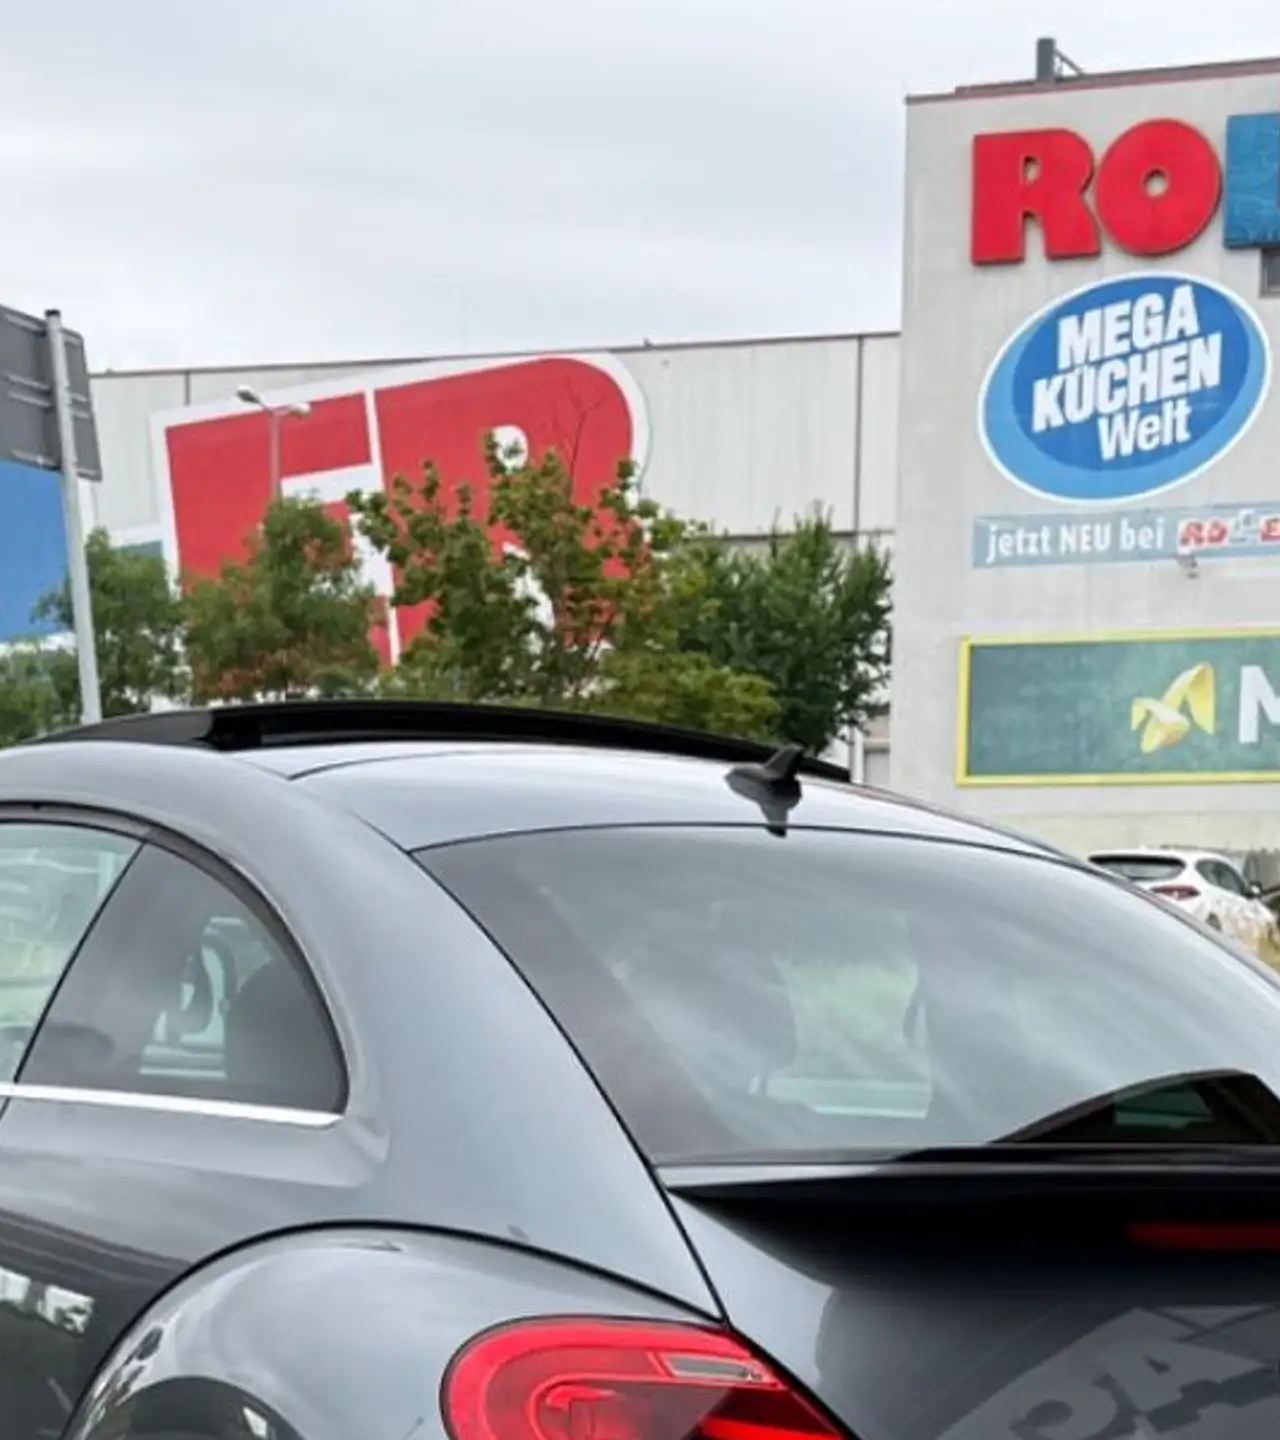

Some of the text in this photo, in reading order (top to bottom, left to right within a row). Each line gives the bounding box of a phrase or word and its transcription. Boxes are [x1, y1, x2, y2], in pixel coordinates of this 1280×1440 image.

[1058, 283, 1200, 370] MEGA
[1032, 332, 1222, 433] KÜCHEN
[1097, 400, 1191, 461] Welt
[986, 525, 1051, 565] jetzt
[1059, 522, 1112, 555] NEU
[1120, 517, 1166, 550] bei
